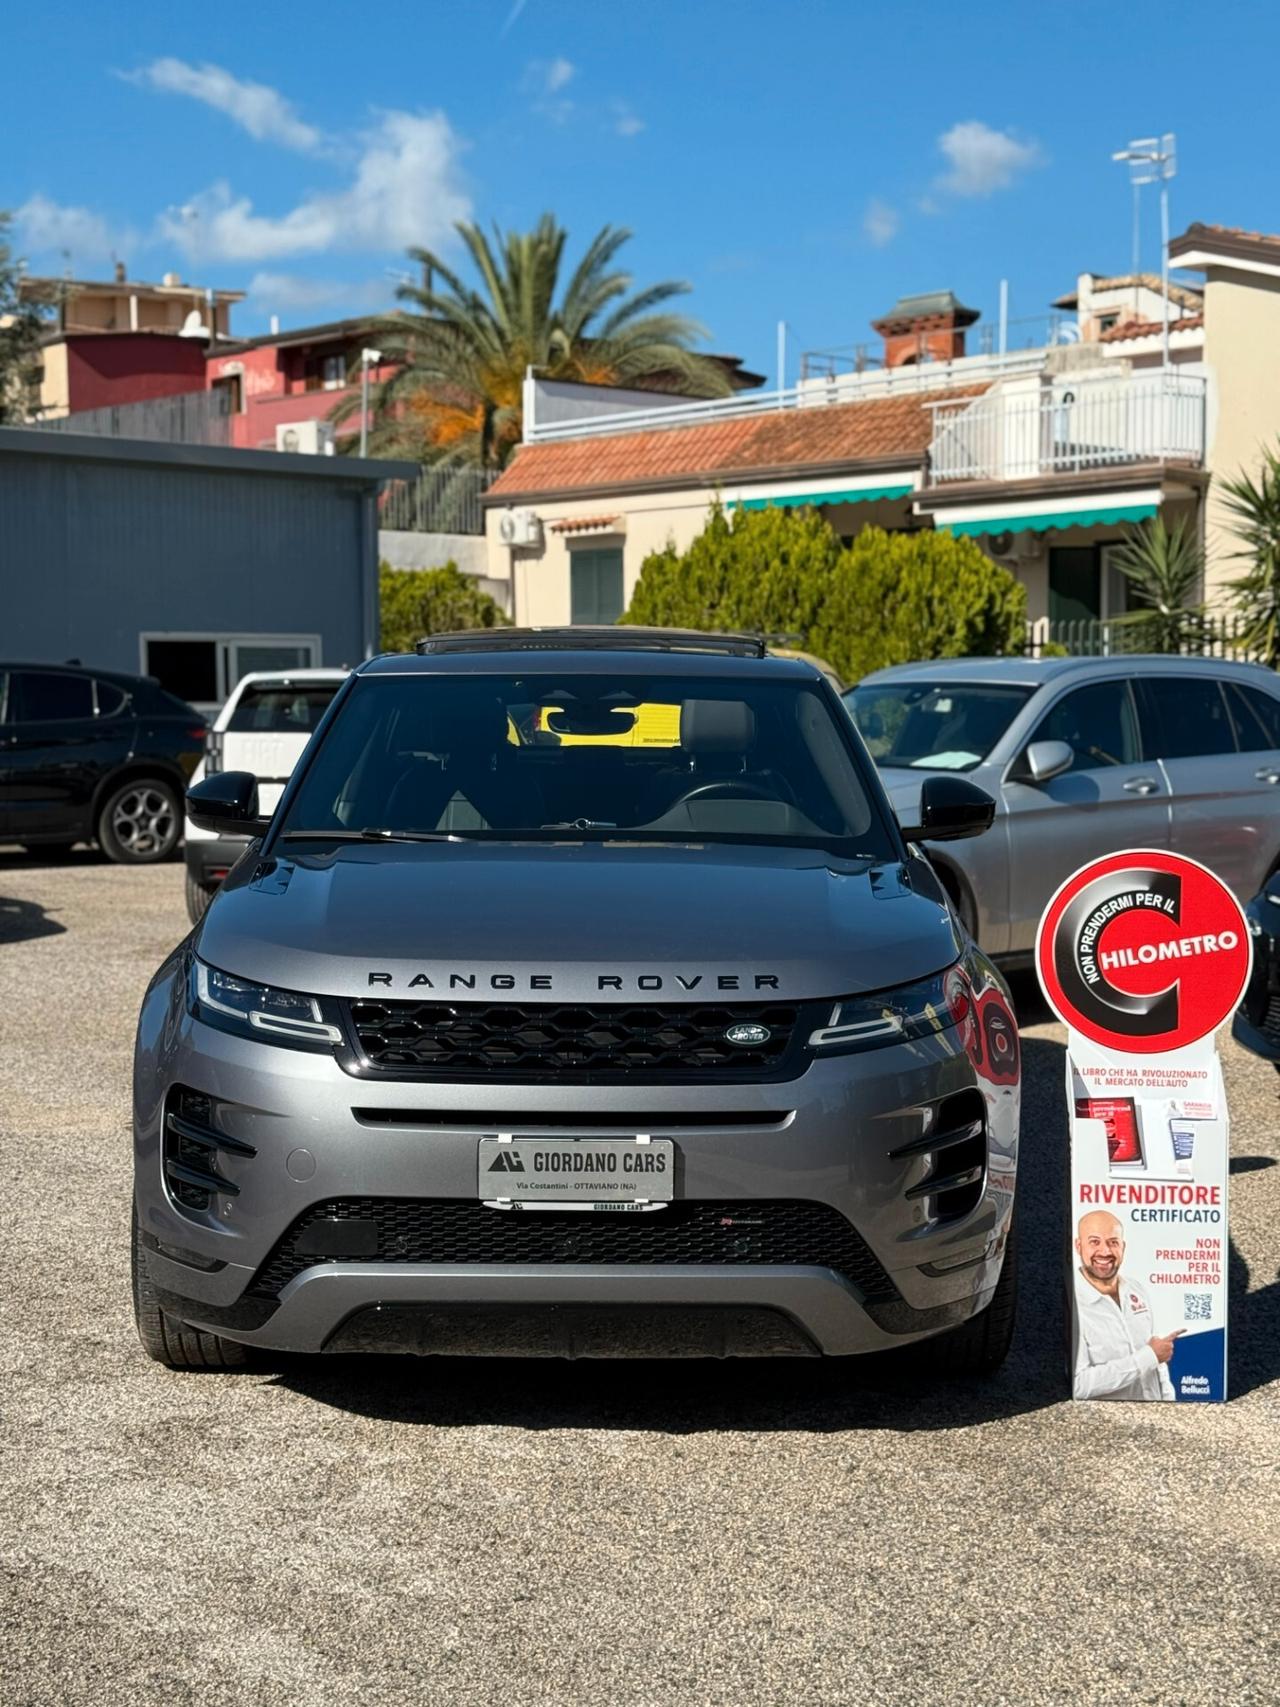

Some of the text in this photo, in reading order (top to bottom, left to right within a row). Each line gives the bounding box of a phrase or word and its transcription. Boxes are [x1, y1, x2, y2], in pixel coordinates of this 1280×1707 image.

[1080, 892, 1176, 985] NON PRENDERMI PER IL
[368, 972, 780, 991] RANGE ROVER
[1073, 1068, 1208, 1079] IL LIBRO CHE HA RIVOLUZIONATO
[1094, 1077, 1188, 1088] IL MERCATO DELL'AUTO
[534, 1152, 617, 1173] GIORDANO
[623, 1153, 666, 1173] CARS
[516, 1182, 528, 1190] Via
[529, 1182, 569, 1190] Costantini
[620, 1183, 637, 1191] (NA)
[1080, 1183, 1221, 1205] RIVENDITORE
[593, 1203, 626, 1211] GIORDANO
[627, 1203, 643, 1211] CARS
[1131, 1208, 1221, 1223] CERTIFICATO
[1196, 1238, 1221, 1249] NON
[1156, 1250, 1221, 1260] PRENDERMI
[1188, 1262, 1221, 1273] PER IL
[1150, 1273, 1221, 1285] CHILOMETRO
[1180, 1375, 1209, 1385] Alfredo
[1181, 1385, 1210, 1394] Bellucci
